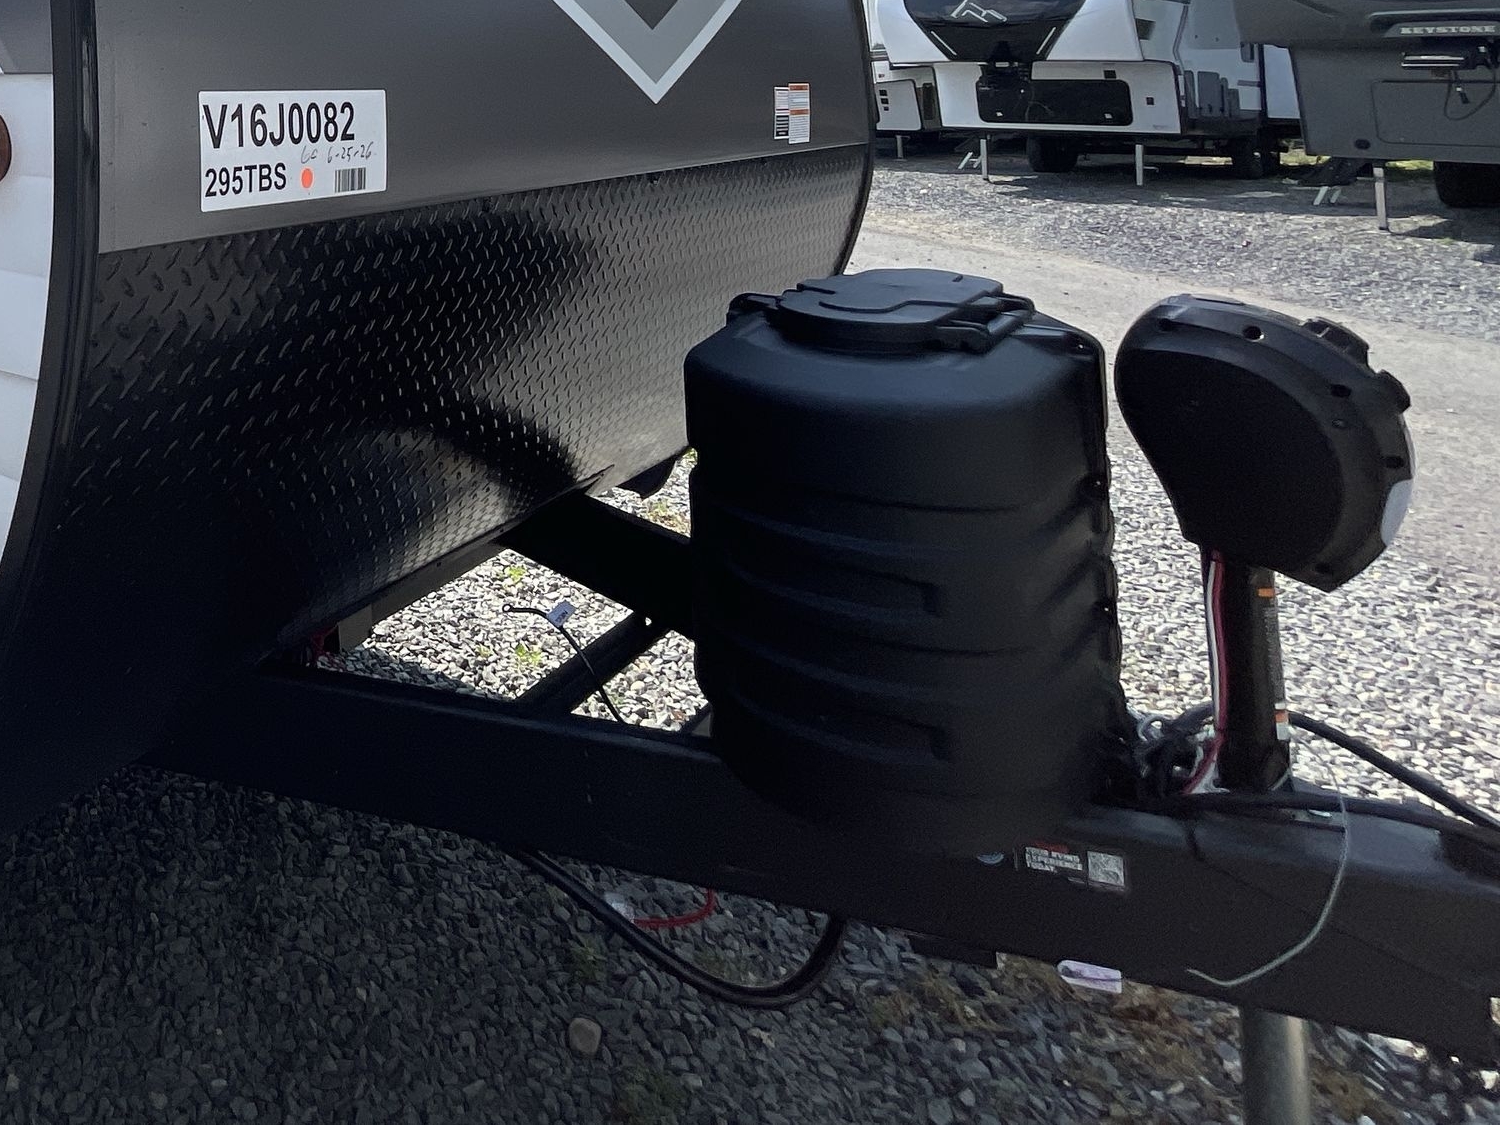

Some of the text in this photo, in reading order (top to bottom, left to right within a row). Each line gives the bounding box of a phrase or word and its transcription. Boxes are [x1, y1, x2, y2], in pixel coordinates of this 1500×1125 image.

[1400, 25, 1496, 34] KEYSTONE
[203, 101, 355, 148] V16J0082
[205, 162, 287, 197] 295TBS
